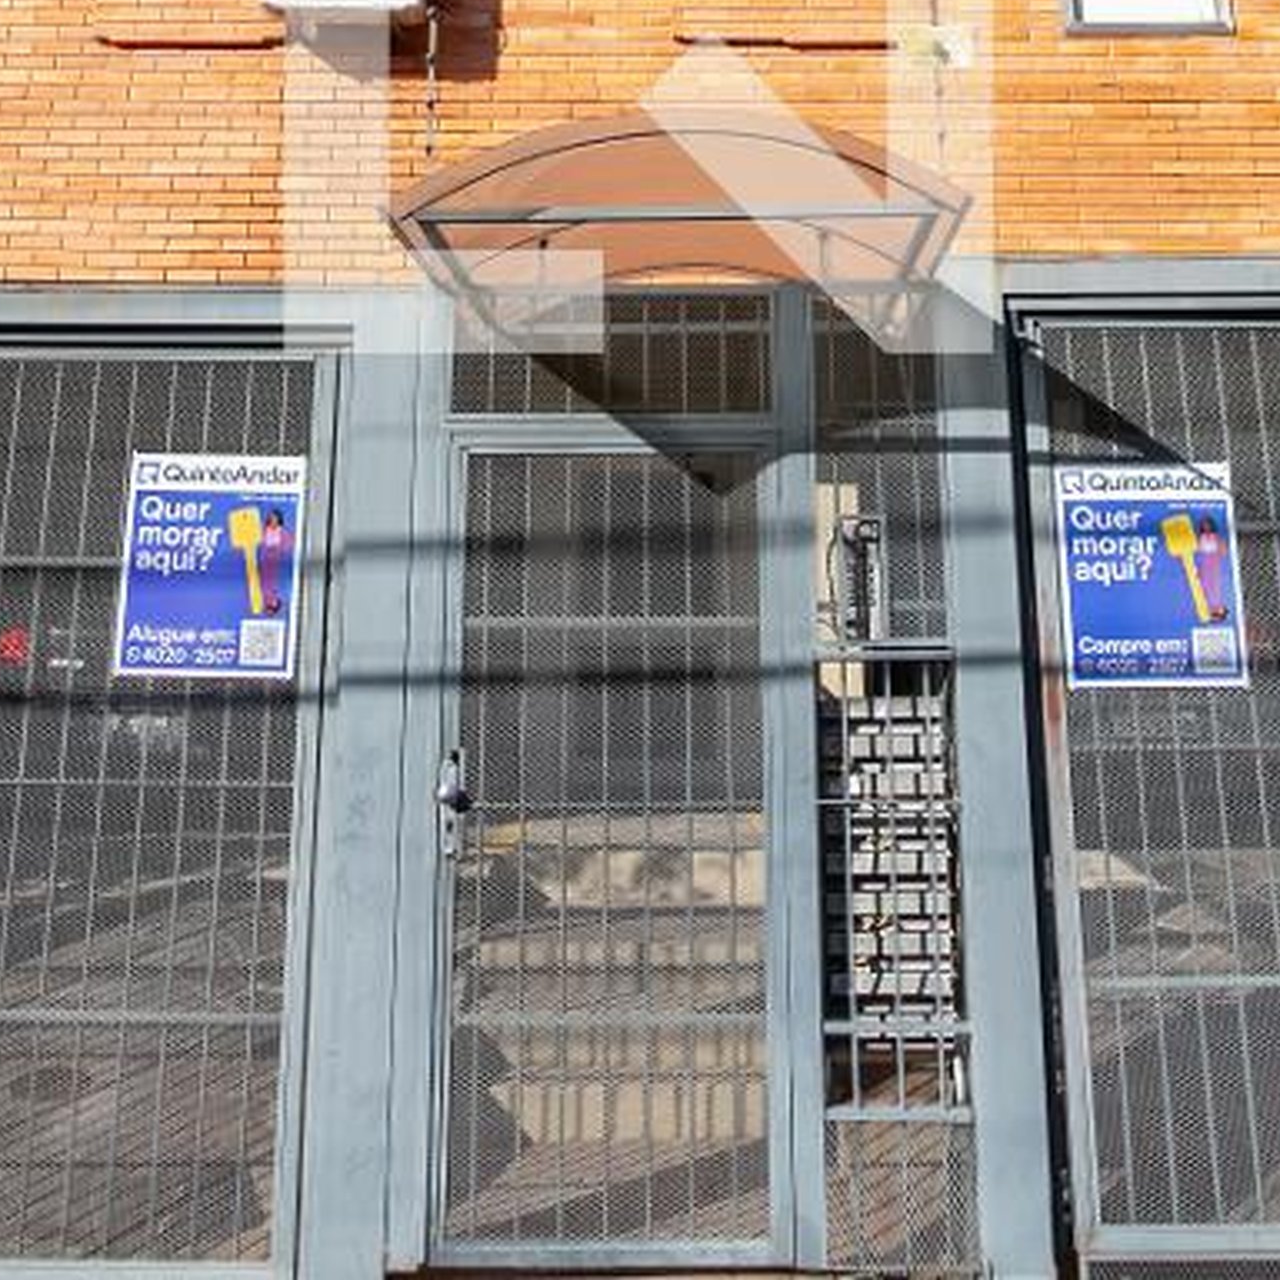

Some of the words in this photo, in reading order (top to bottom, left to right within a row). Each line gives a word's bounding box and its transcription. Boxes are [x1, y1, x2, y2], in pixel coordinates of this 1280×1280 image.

[162, 463, 300, 486] QuintoAndar
[140, 496, 212, 522] Quer
[1070, 506, 1143, 532] Quer
[138, 524, 223, 547] morar
[1071, 535, 1158, 556] morar
[134, 546, 215, 577] aqui?
[1074, 556, 1153, 587] aqui?
[126, 624, 197, 647] Alugue
[1078, 636, 1153, 658] Compre
